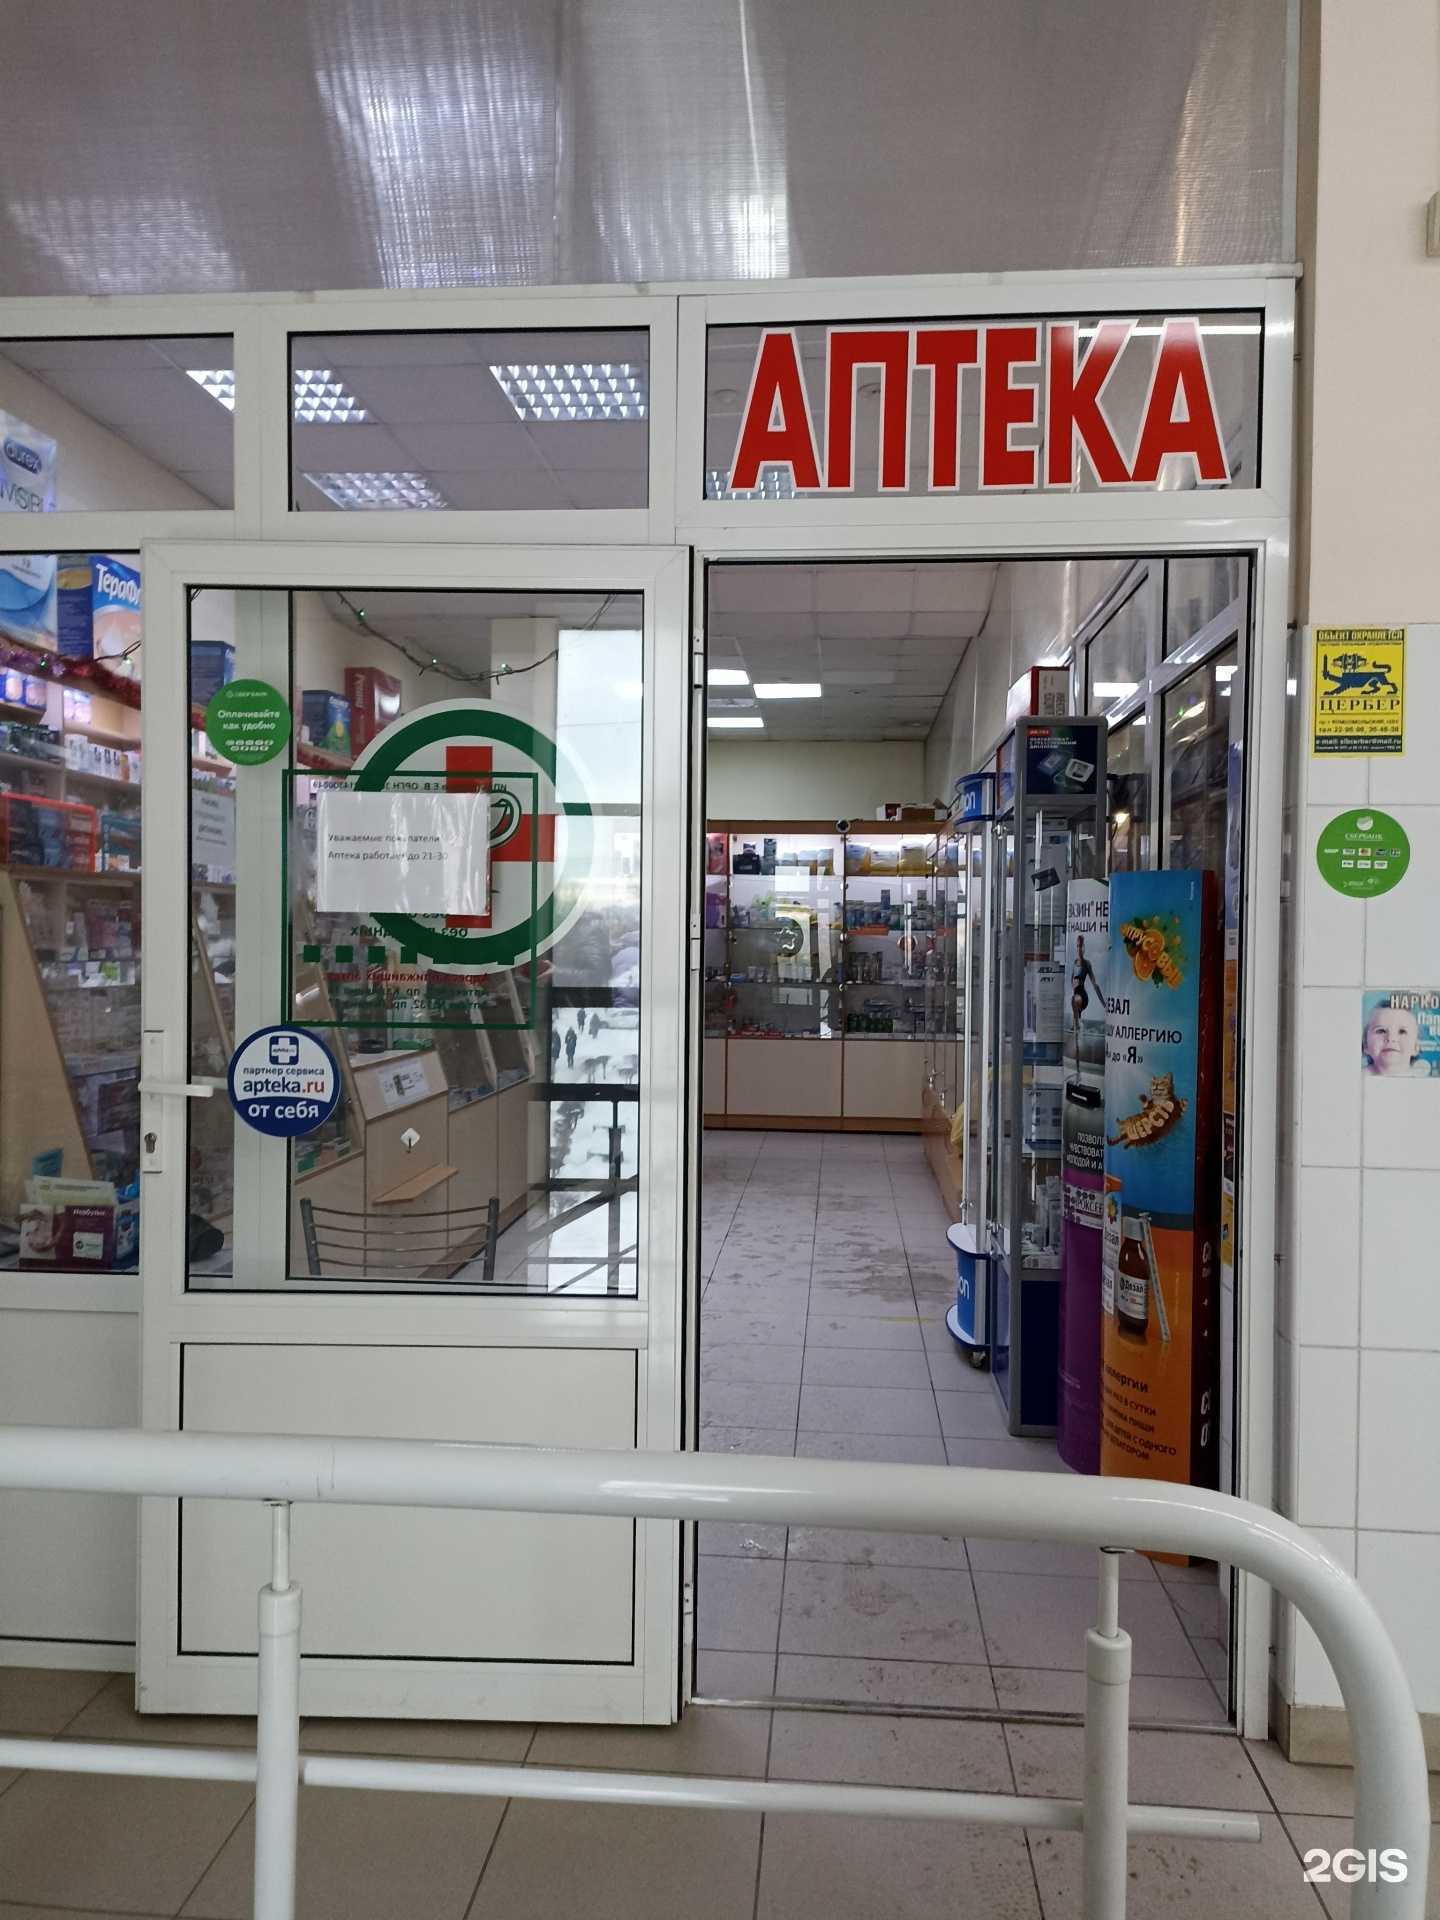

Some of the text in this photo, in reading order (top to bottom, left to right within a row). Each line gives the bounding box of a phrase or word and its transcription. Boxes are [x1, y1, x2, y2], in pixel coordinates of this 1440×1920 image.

[727, 317, 1232, 492] АПТЕКА
[1351, 630, 1403, 640] ОХРАНЯЕТСЯ
[1320, 699, 1400, 713] ЦЕРБЕР
[217, 709, 281, 719] Оплачивайте
[241, 720, 276, 732] удобно
[328, 834, 383, 843] Уважаемые
[328, 851, 360, 861] Аптека
[407, 852, 420, 862] до
[1115, 1026, 1182, 1045] АЛЛЕРГИЮ
[242, 1067, 325, 1077] партнер сервиса
[242, 1077, 325, 1096] apteka.ru
[248, 1100, 319, 1119] от себя
